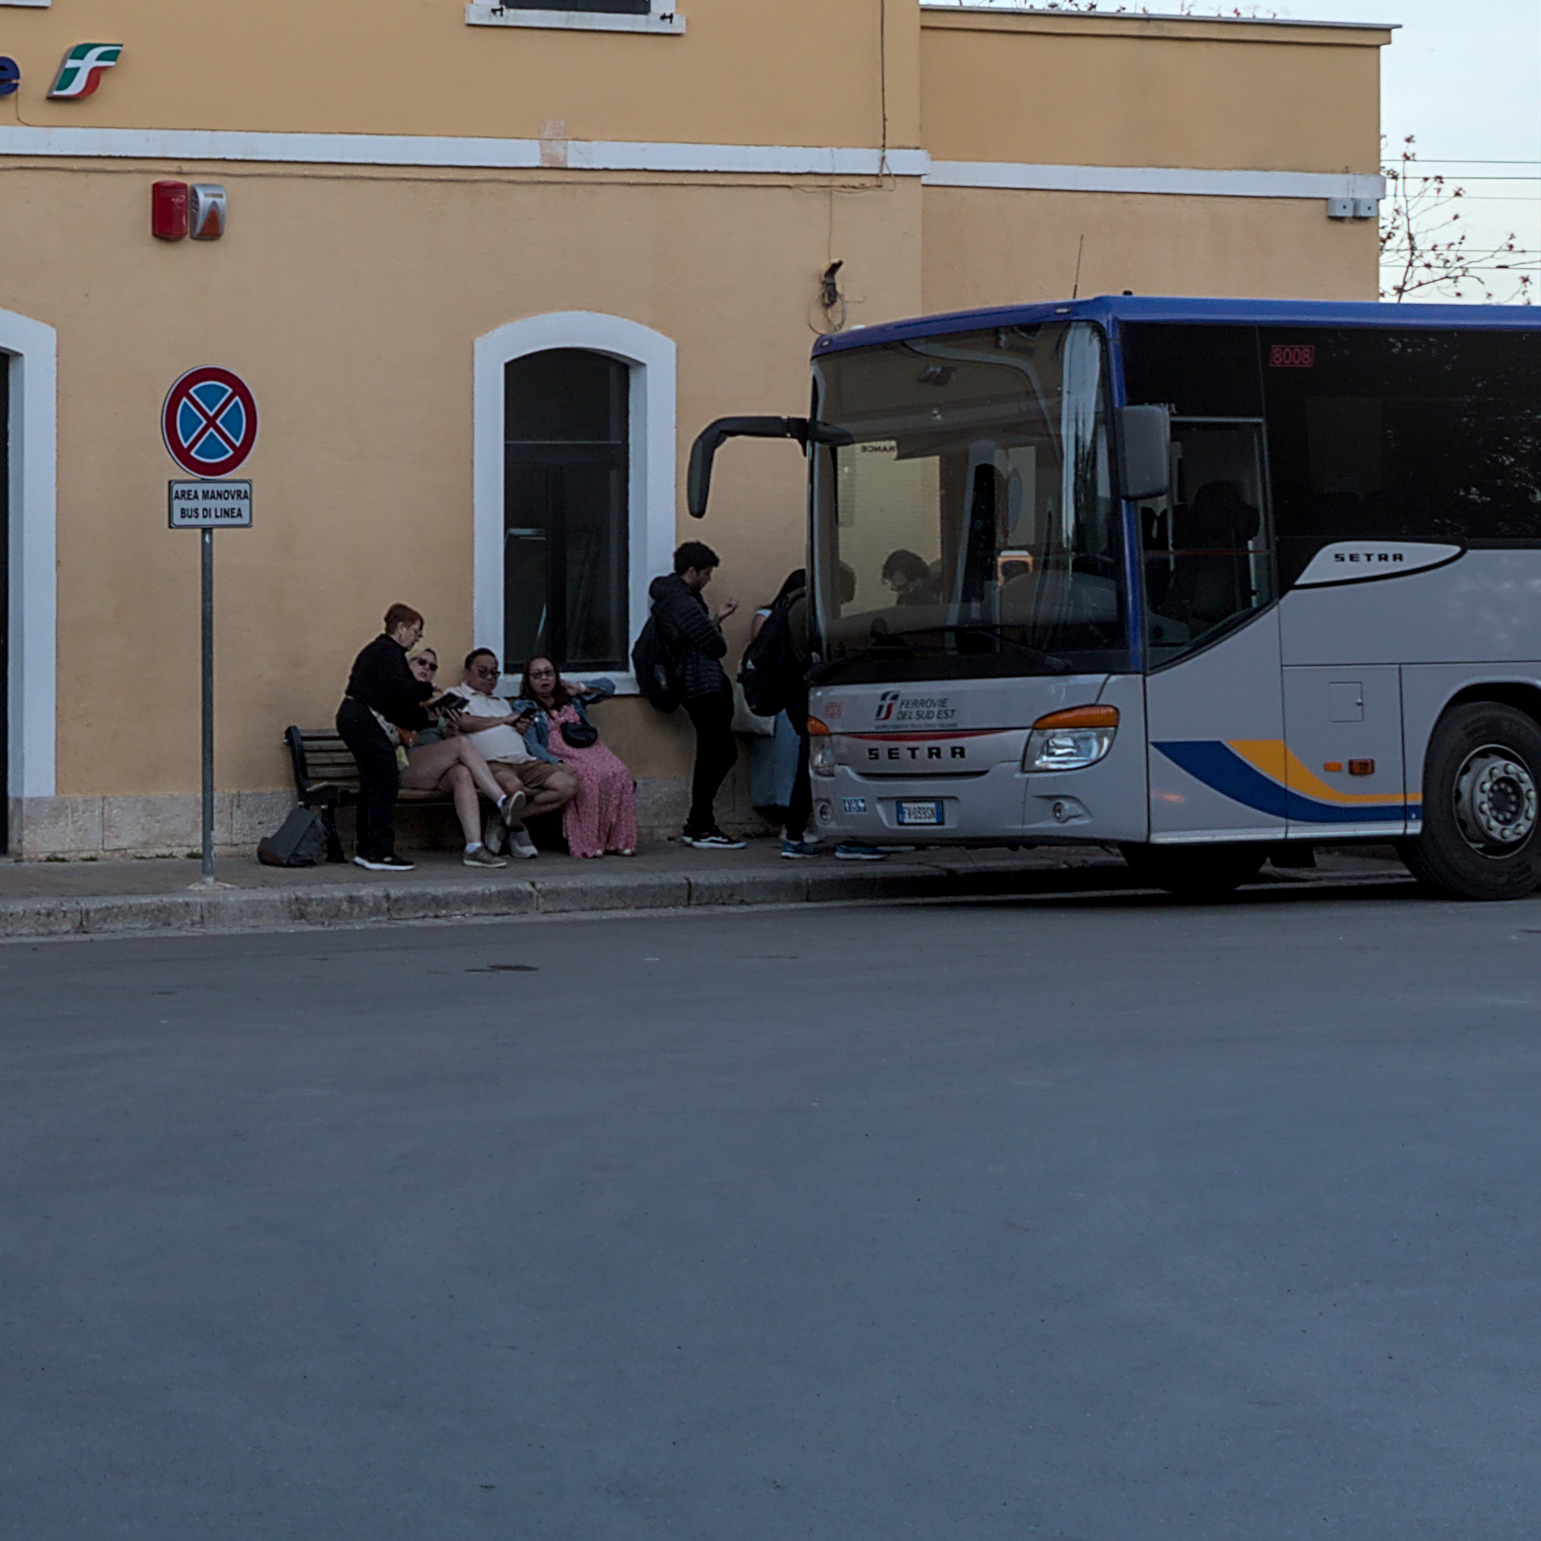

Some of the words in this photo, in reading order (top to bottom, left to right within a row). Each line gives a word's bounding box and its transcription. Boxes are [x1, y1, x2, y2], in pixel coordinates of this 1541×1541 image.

[1273, 348, 1311, 364] 8008
[174, 489, 199, 501] AREA
[201, 489, 249, 501] MANOVRA
[180, 507, 199, 519] BUS
[202, 507, 212, 519] DI
[214, 507, 243, 519] LINEA
[1334, 553, 1404, 562] SETRA
[900, 698, 949, 709] FERROVIE
[896, 710, 913, 721] DEL
[915, 710, 934, 720] SUD
[936, 709, 956, 719] EST
[868, 746, 966, 761] SETRA
